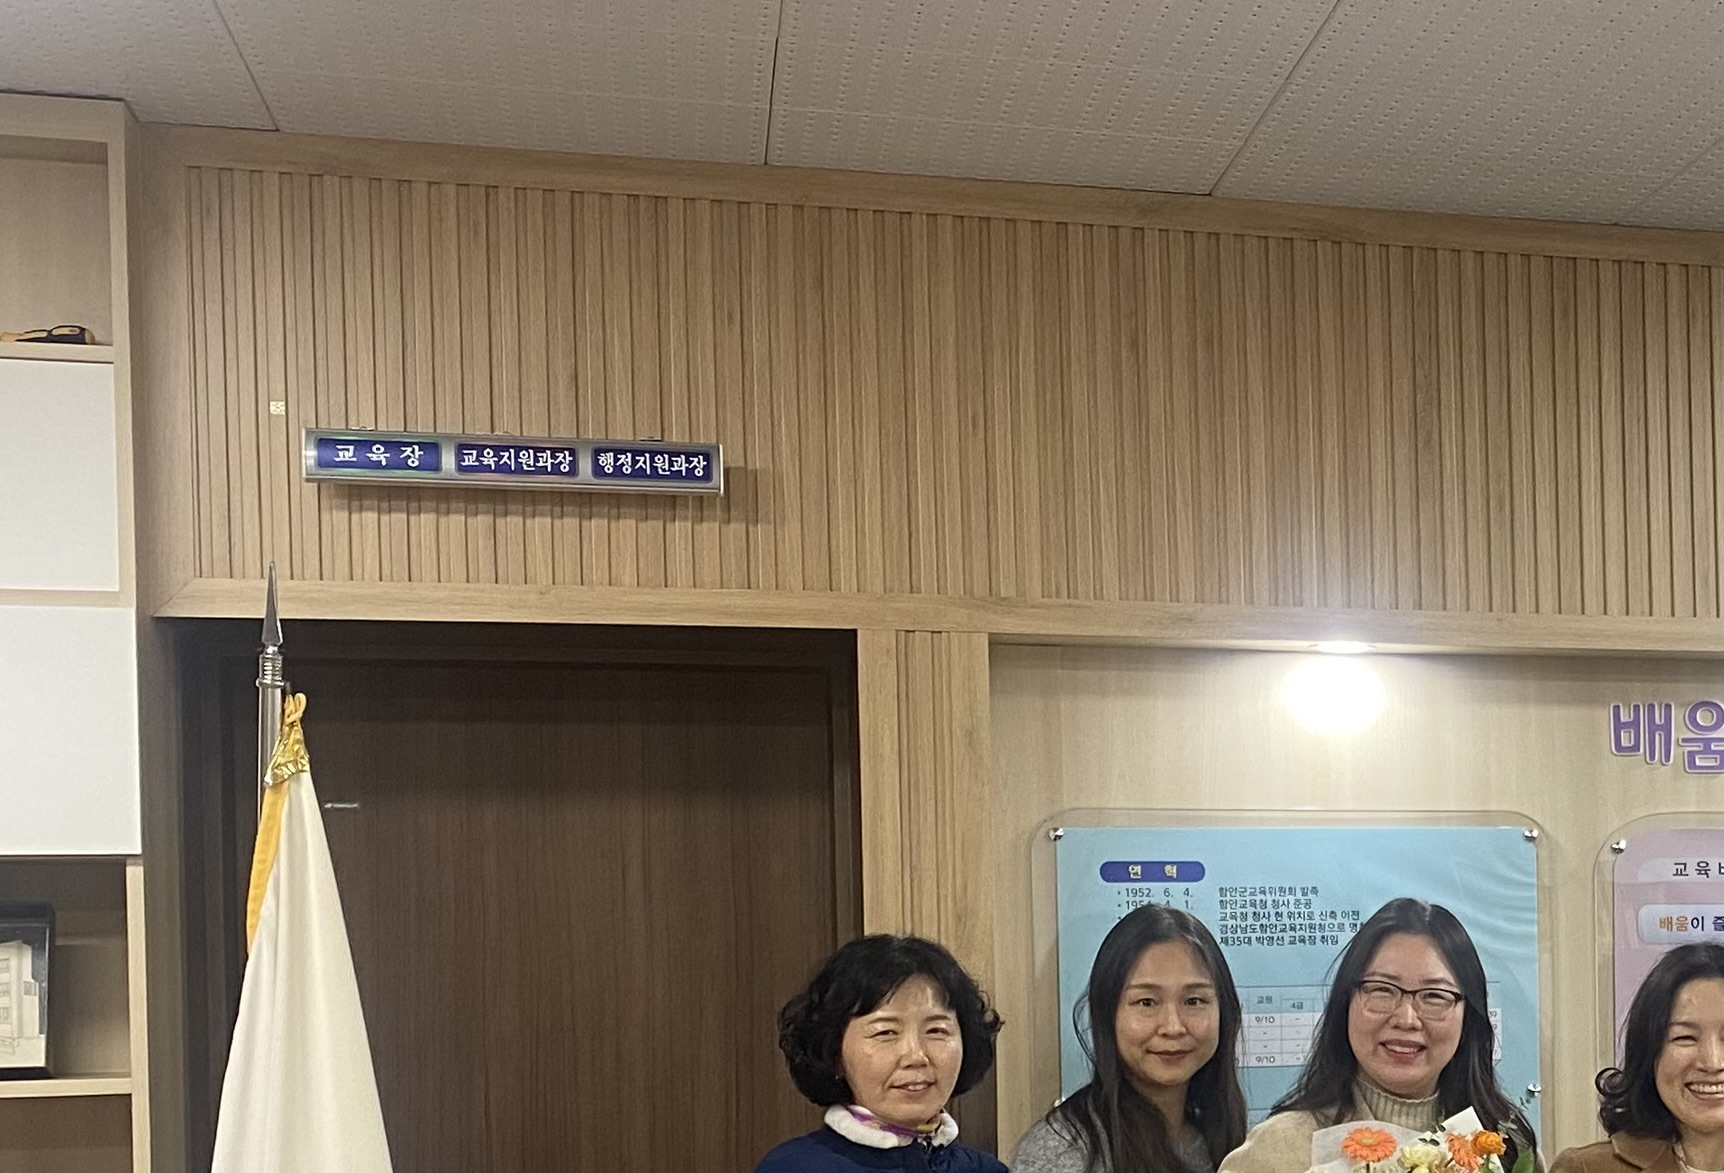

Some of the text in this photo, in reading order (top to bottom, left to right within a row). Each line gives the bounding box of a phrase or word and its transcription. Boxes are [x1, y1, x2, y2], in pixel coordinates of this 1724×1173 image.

[460, 447, 573, 474] 교육지원과장
[597, 452, 708, 478] 행정지원과장
[1218, 898, 1268, 910] 함안교육청
[1218, 910, 1249, 922] 교육청
[1251, 910, 1271, 922] 청사
[1286, 910, 1316, 922] 위치로
[1340, 909, 1360, 921] 이전
[1219, 922, 1346, 935] 경상남도함안교육지원청으로
[1659, 915, 1706, 933] 배움이
[1218, 935, 1252, 947] 제35대
[1287, 935, 1317, 947] 교육장
[1320, 934, 1339, 946] 취임
[1254, 1015, 1276, 1024] 9/10
[1255, 1055, 1276, 1064] 9/10
